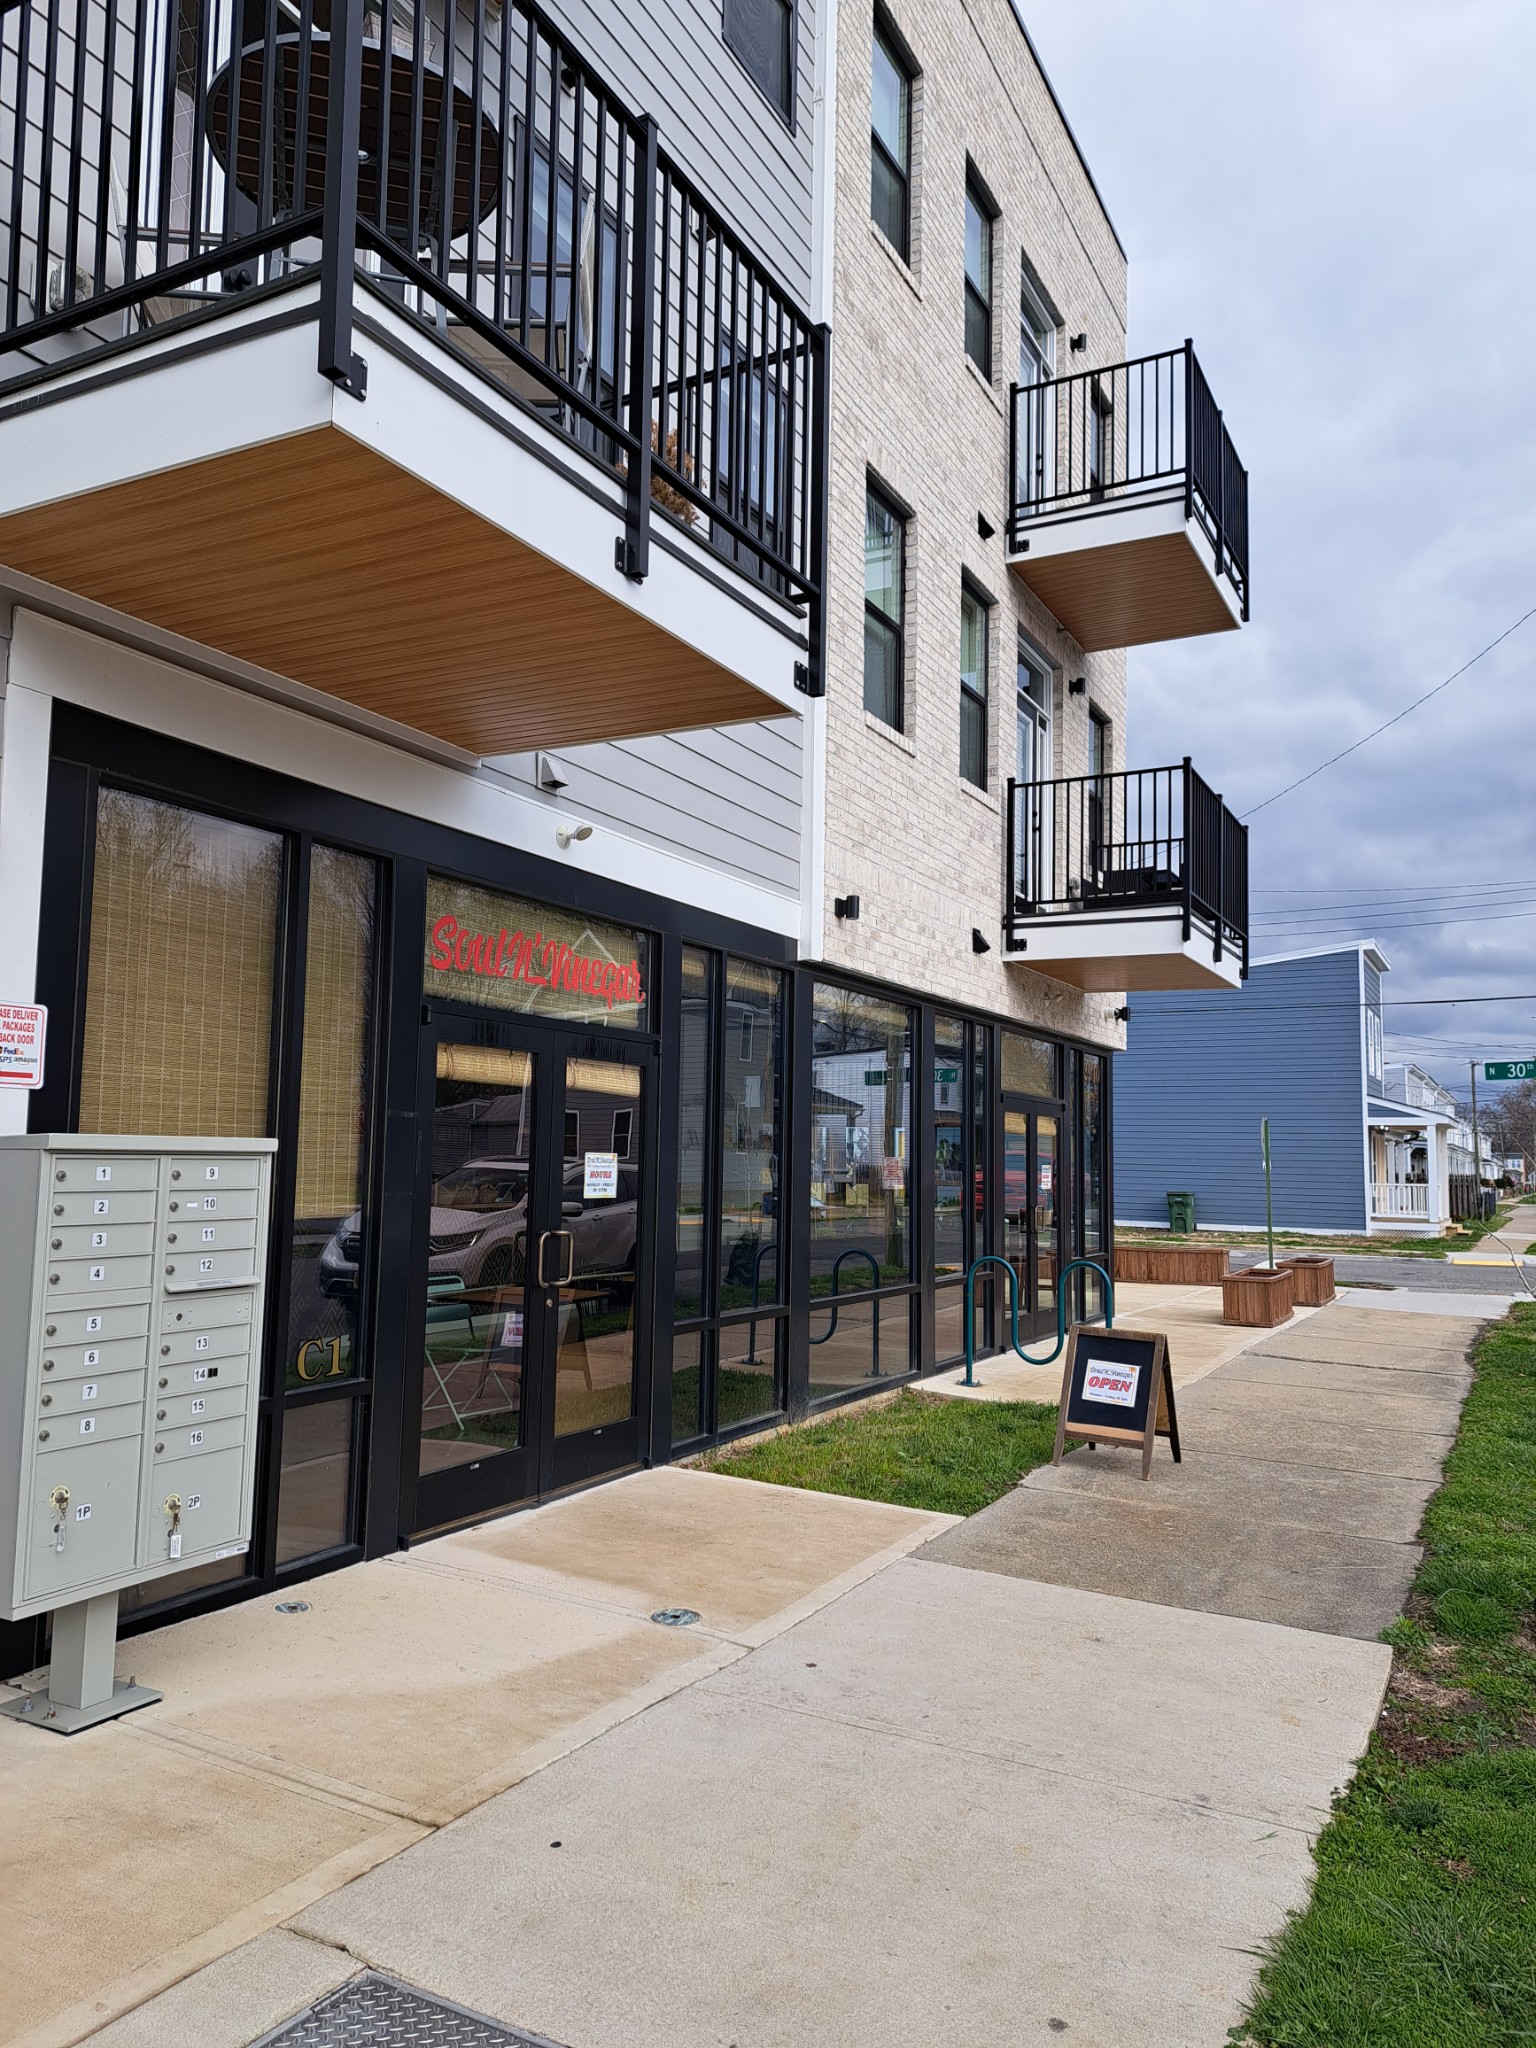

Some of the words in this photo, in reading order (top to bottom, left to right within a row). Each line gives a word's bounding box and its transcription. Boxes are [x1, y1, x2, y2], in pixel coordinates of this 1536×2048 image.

[430, 914, 508, 978] Soul
[543, 940, 646, 1010] Vinegar
[13, 1009, 39, 1021] DELIVER
[2, 1021, 35, 1033] PACKAGES
[17, 1034, 35, 1045] DOOR
[3, 1047, 25, 1055] FedEx
[1489, 1066, 1496, 1076] N
[1507, 1063, 1535, 1078] 30th
[101, 1169, 107, 1178] 1
[209, 1168, 215, 1178] 9
[98, 1202, 105, 1212] 2
[204, 1199, 216, 1208] 10
[203, 1230, 214, 1239] 11
[96, 1235, 103, 1245] 3
[201, 1260, 213, 1270] 12
[93, 1268, 101, 1278] 4
[91, 1318, 97, 1329] 5
[197, 1338, 207, 1348] 13
[88, 1352, 95, 1362] 6
[296, 1335, 345, 1382] C1
[194, 1370, 206, 1380] 14
[1088, 1376, 1133, 1392] OPEN
[86, 1386, 93, 1397] 7
[192, 1401, 204, 1411] 15
[84, 1421, 91, 1431] 8
[191, 1432, 202, 1443] 16
[188, 1496, 200, 1508] 2P
[76, 1506, 91, 1519] 1P
